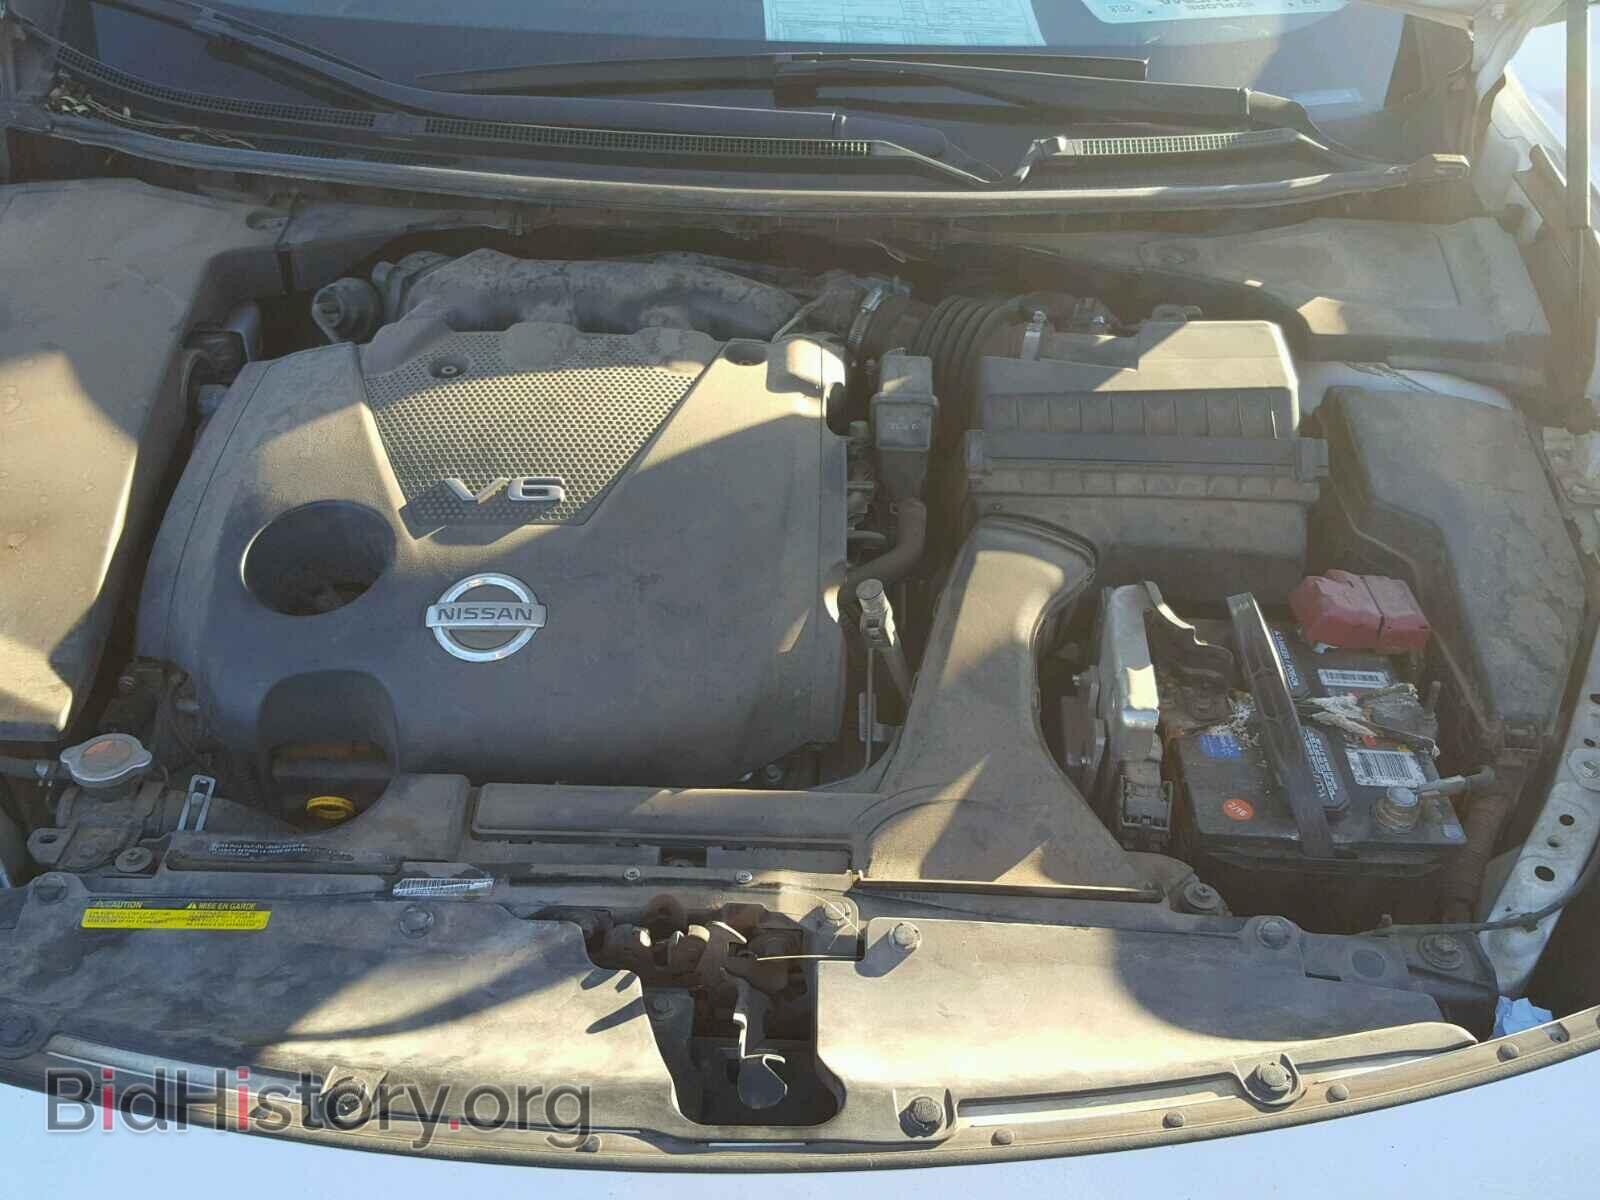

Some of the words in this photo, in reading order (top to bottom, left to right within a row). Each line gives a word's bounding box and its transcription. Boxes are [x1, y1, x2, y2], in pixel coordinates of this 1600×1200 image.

[446, 476, 564, 505] V6
[438, 606, 532, 621] NISSAN
[217, 903, 229, 911] EN
[229, 902, 257, 912] GARDE
